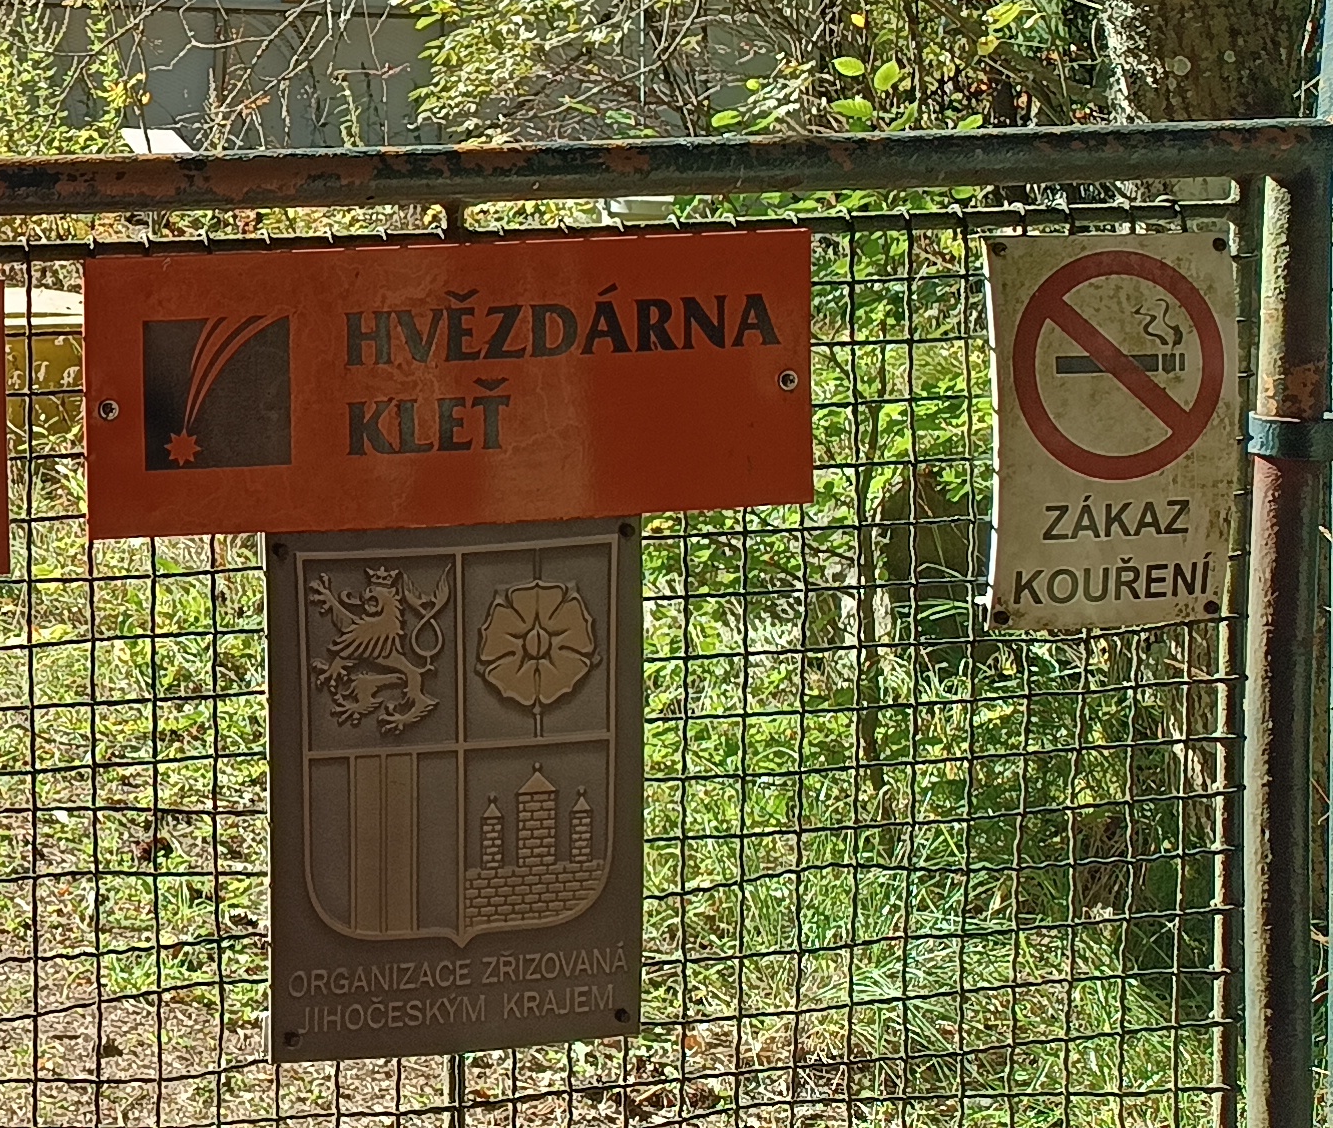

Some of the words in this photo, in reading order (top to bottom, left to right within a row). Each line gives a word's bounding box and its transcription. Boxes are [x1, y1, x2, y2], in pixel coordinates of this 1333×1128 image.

[344, 283, 781, 368] HVĚZDÁRNA
[346, 377, 511, 457] KLEŤ
[1042, 494, 1190, 540] ZÁKAZ
[1013, 551, 1212, 605] KOUŘENÍ
[288, 958, 471, 997] ORGANIZACE
[482, 941, 628, 983] ZŘIZOVANÁ
[297, 992, 485, 1035] JIHOČESKÝM
[503, 984, 614, 1020] KRAJEM
